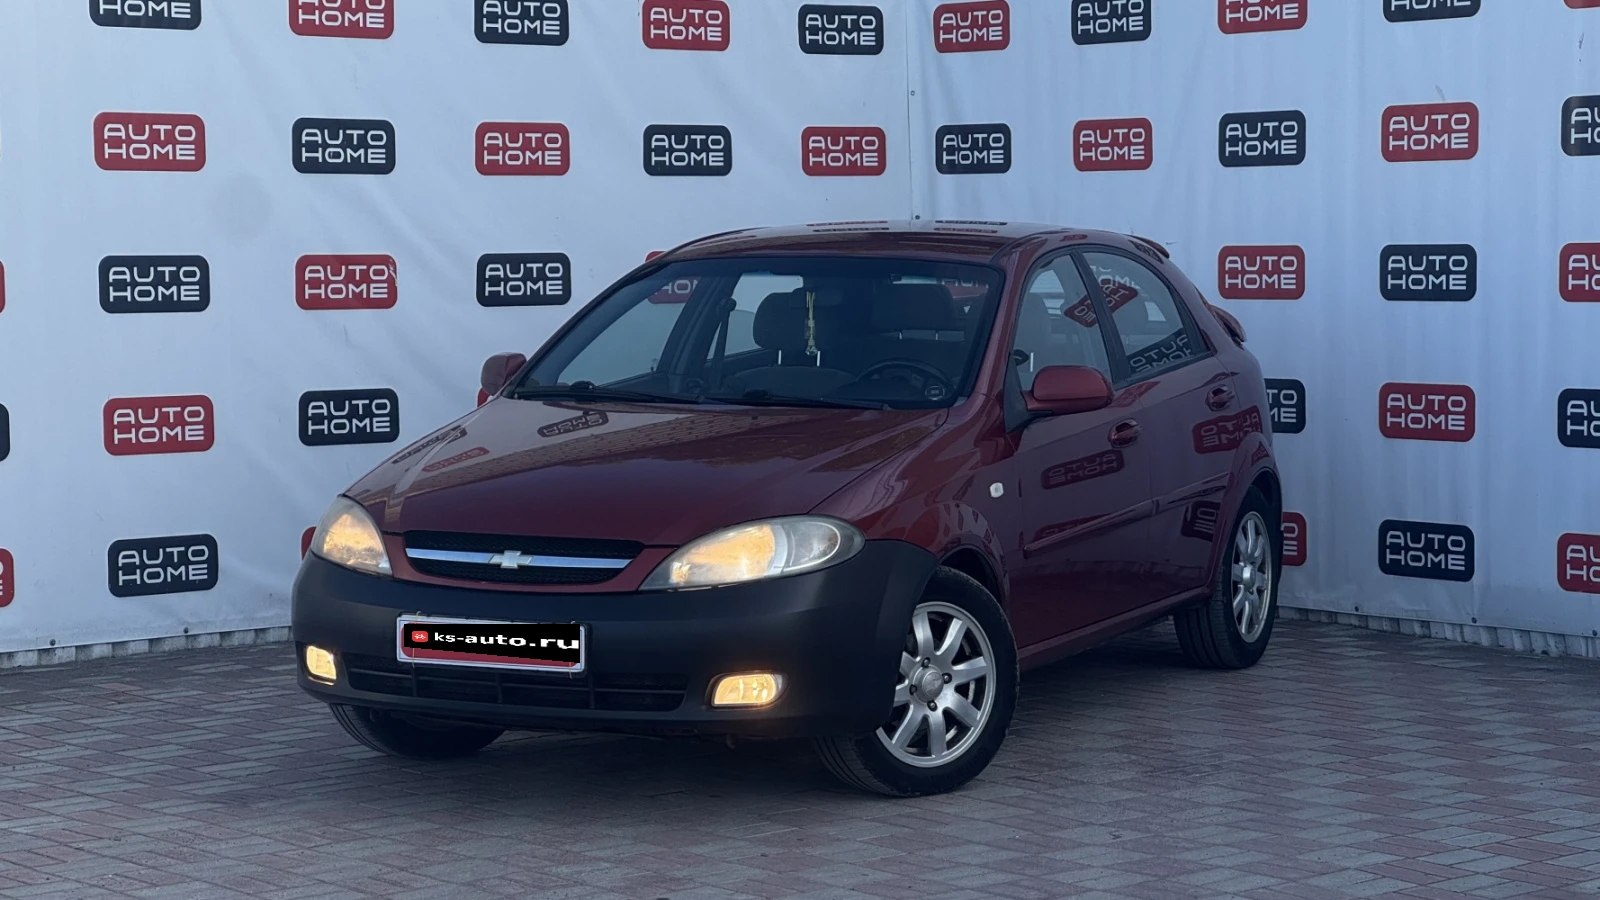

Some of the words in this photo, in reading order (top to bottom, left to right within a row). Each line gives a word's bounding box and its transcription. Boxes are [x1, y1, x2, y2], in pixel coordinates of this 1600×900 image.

[100, 0, 190, 18] HOME
[483, 0, 560, 17] AUTO
[651, 8, 722, 24] AUTO
[1078, 0, 1144, 17] AUTO
[1226, 3, 1298, 23] HOME
[299, 9, 385, 28] HOME
[483, 18, 560, 35] HOME
[806, 14, 876, 29] AUTO
[940, 10, 1003, 27] AUTO
[1078, 16, 1144, 34] HOME
[651, 25, 722, 41] HOME
[806, 31, 876, 45] HOME
[940, 27, 1003, 43] HOME
[1226, 121, 1298, 138] AUTO
[1390, 114, 1470, 131] AUTO
[104, 124, 196, 141] AUTO
[302, 129, 386, 145] AUTO
[484, 133, 561, 147] AUTO
[1080, 128, 1145, 144] AUTO
[652, 135, 724, 149] AUTO
[809, 137, 878, 150] AUTO
[943, 134, 1004, 148] AUTO
[1226, 140, 1297, 156] HOME
[1389, 133, 1469, 150] HOME
[104, 143, 196, 160] HOME
[302, 147, 386, 163] HOME
[484, 150, 562, 165] HOME
[652, 152, 724, 165] HOME
[809, 153, 878, 166] HOME
[943, 150, 1004, 164] HOME
[1080, 146, 1145, 161] HOME
[485, 263, 563, 278] AUTO
[1226, 256, 1297, 270] AUTO
[1388, 256, 1468, 270] AUTO
[109, 267, 200, 282] AUTO
[305, 265, 388, 280] AUTO
[485, 281, 563, 296] HOME
[1226, 274, 1297, 288] HOME
[1388, 275, 1467, 290] HOME
[109, 285, 200, 301] HOME
[305, 283, 388, 299] HOME
[1266, 389, 1298, 404] TO
[1387, 394, 1466, 411] AUTO
[114, 406, 205, 425] AUTO
[308, 399, 390, 416] AUTO
[308, 417, 390, 435] HOME
[1387, 412, 1465, 430] HOME
[114, 425, 204, 444] HOME
[1386, 530, 1465, 551] AUTO
[118, 545, 208, 566] AUTO
[1386, 549, 1465, 570] HOME
[118, 564, 208, 585] HOME
